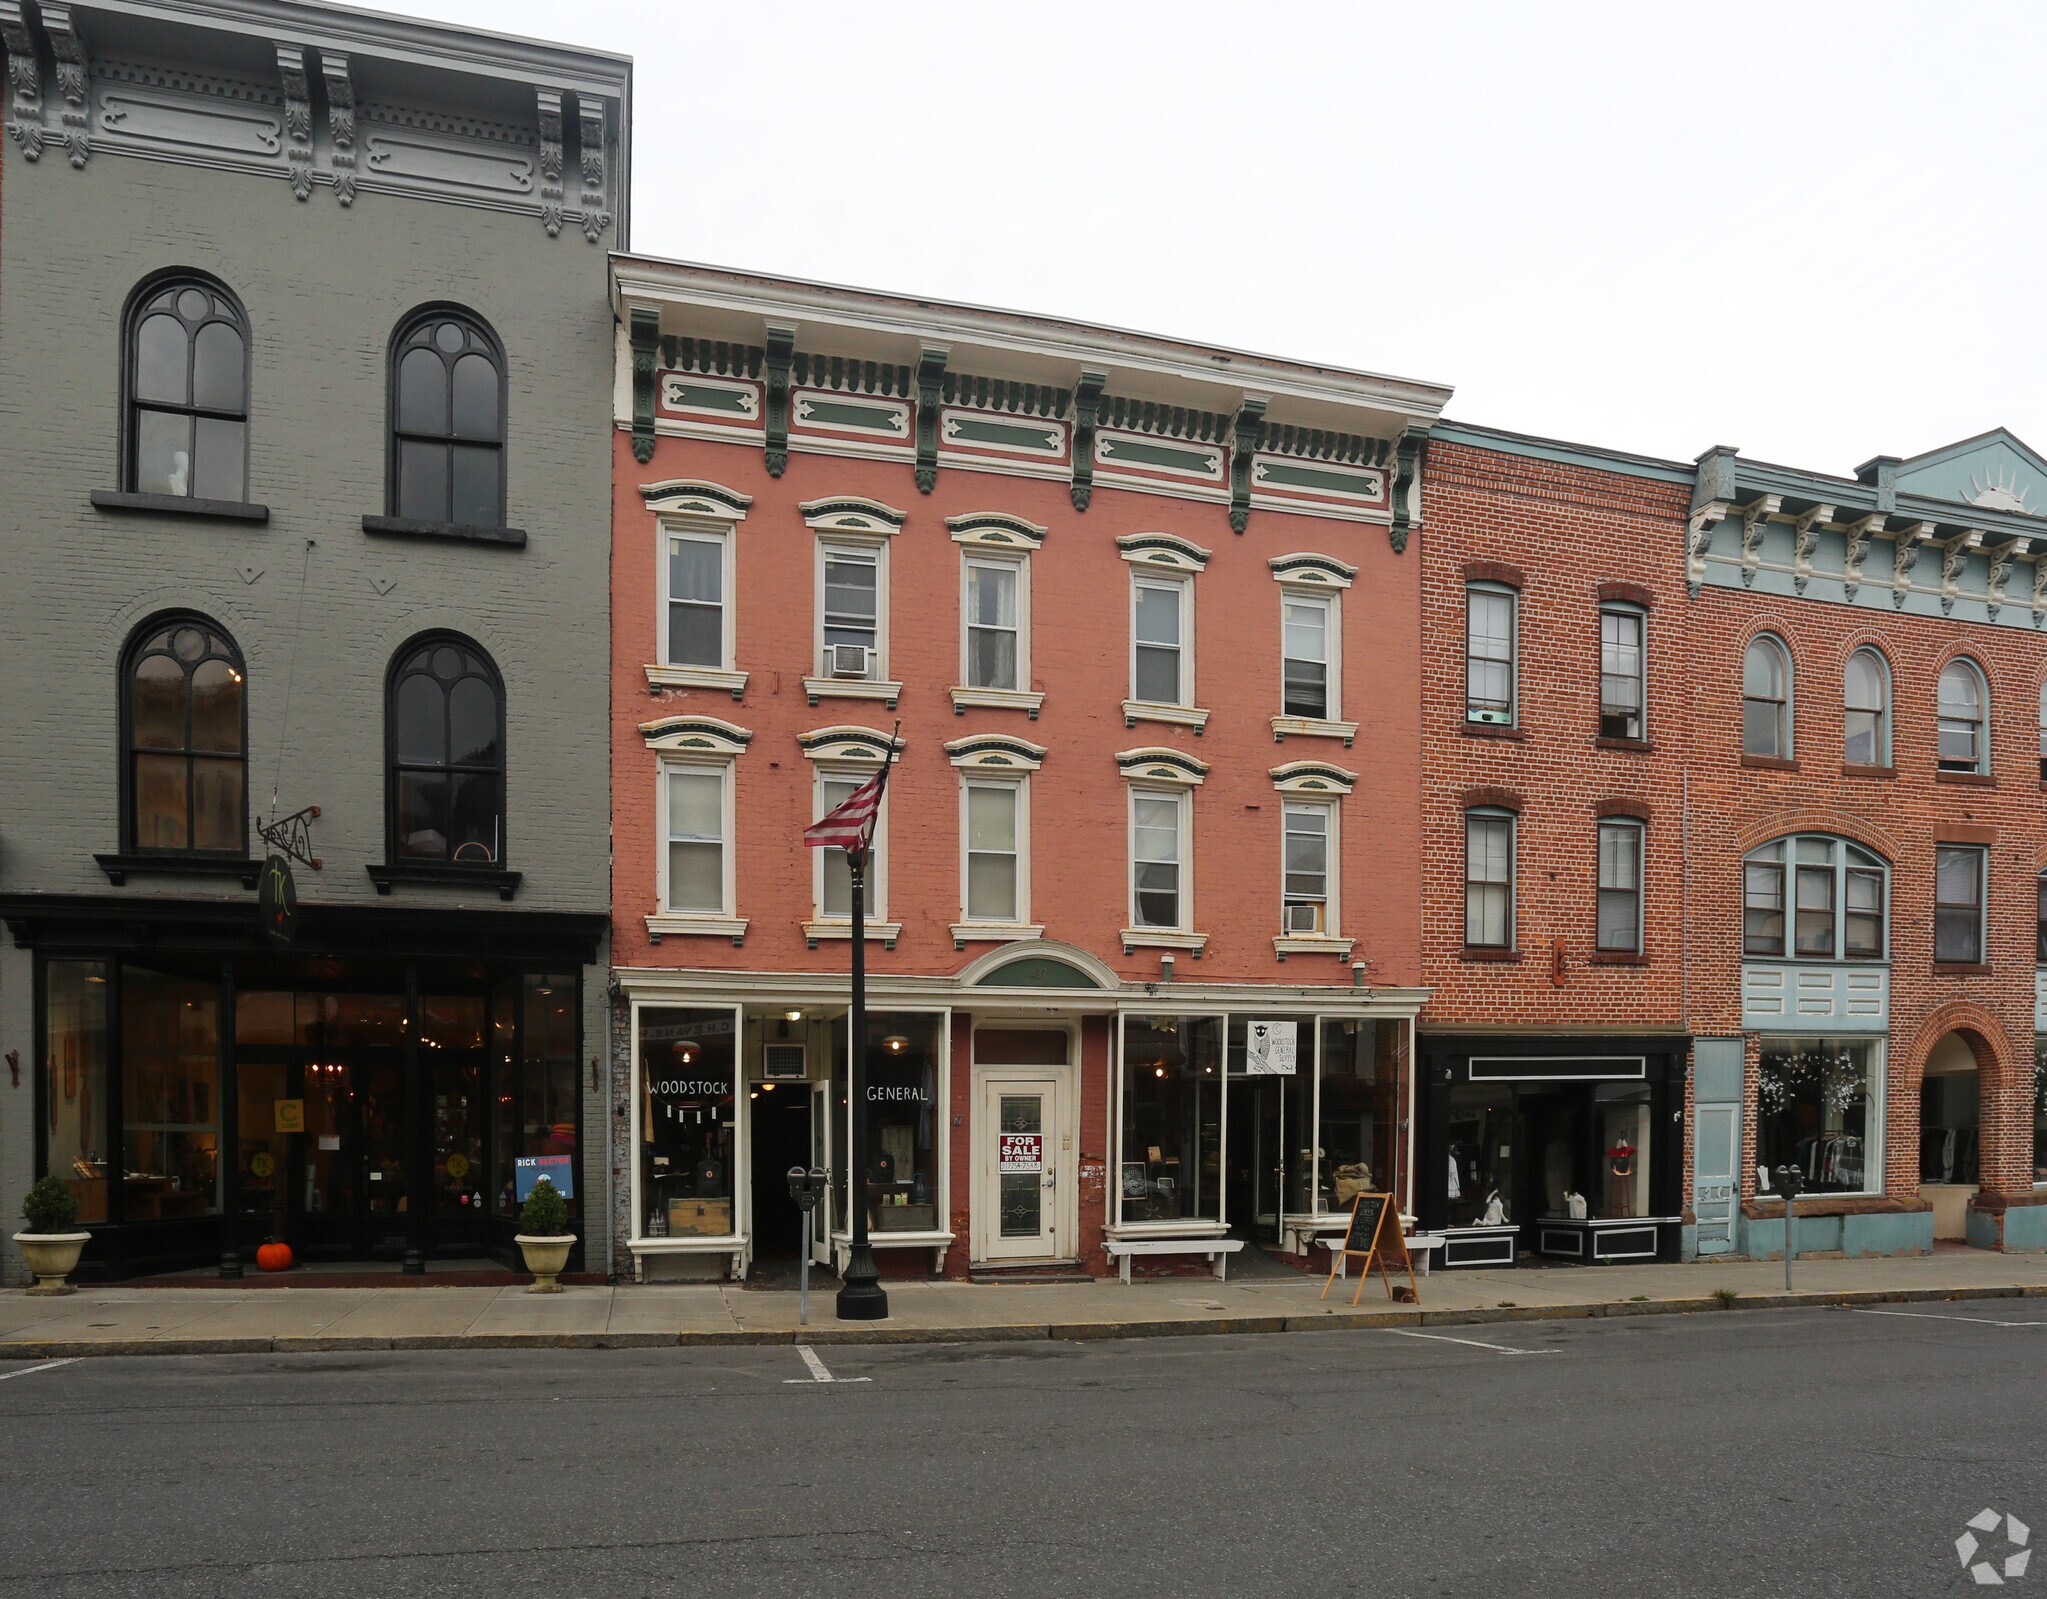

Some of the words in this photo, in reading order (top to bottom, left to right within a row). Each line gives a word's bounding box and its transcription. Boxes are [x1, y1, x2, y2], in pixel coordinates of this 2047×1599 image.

[1275, 1046, 1295, 1055] GENERAL
[1279, 1054, 1295, 1063] SUPPLY
[646, 1080, 728, 1095] WOODSTOCK
[866, 1086, 929, 1101] GENERAL
[1006, 1136, 1035, 1146] FOR
[1001, 1145, 1040, 1155] SALE
[517, 1158, 536, 1167] RICK
[538, 1157, 570, 1165] RECTOR
